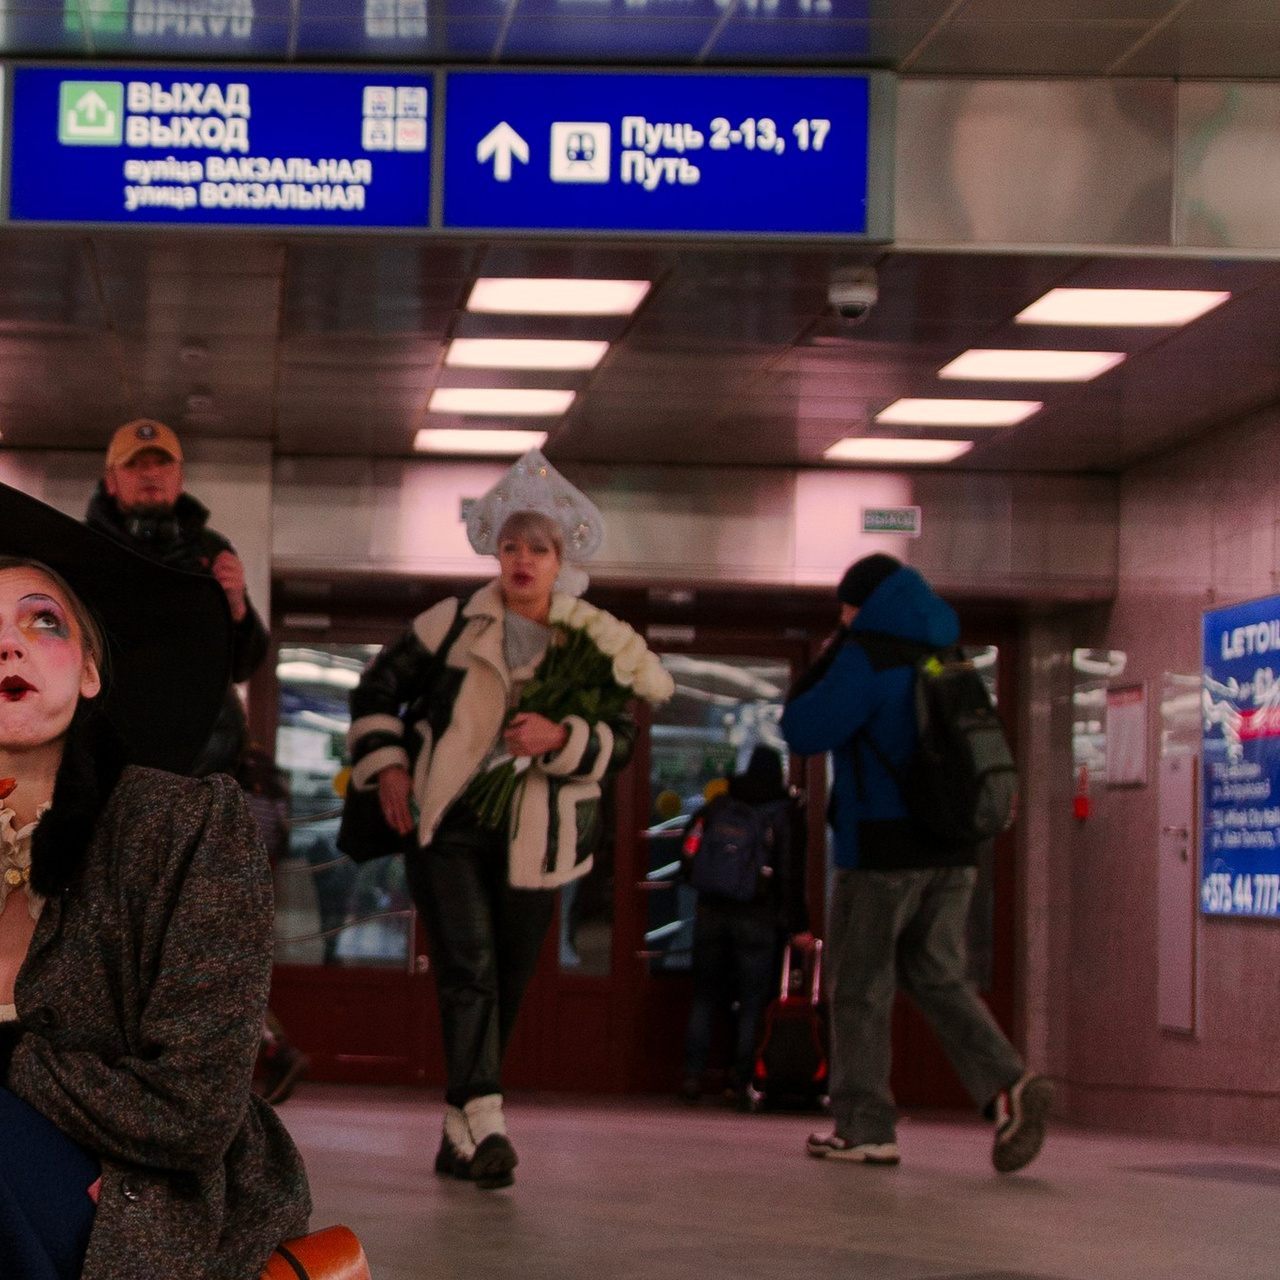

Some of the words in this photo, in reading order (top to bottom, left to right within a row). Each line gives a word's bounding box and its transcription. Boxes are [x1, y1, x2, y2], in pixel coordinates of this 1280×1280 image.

[127, 81, 251, 118] ВЫХАД
[126, 116, 250, 153] ВЫХОД
[621, 116, 705, 155] Пуць
[709, 117, 786, 156] 2-13,
[793, 118, 832, 151] 17
[205, 156, 372, 184] ВАКЗАЛЬНАЯ
[621, 150, 701, 191] Путь
[124, 184, 197, 211] улица
[199, 182, 366, 210] ВОКЗАЛЬНАЯ
